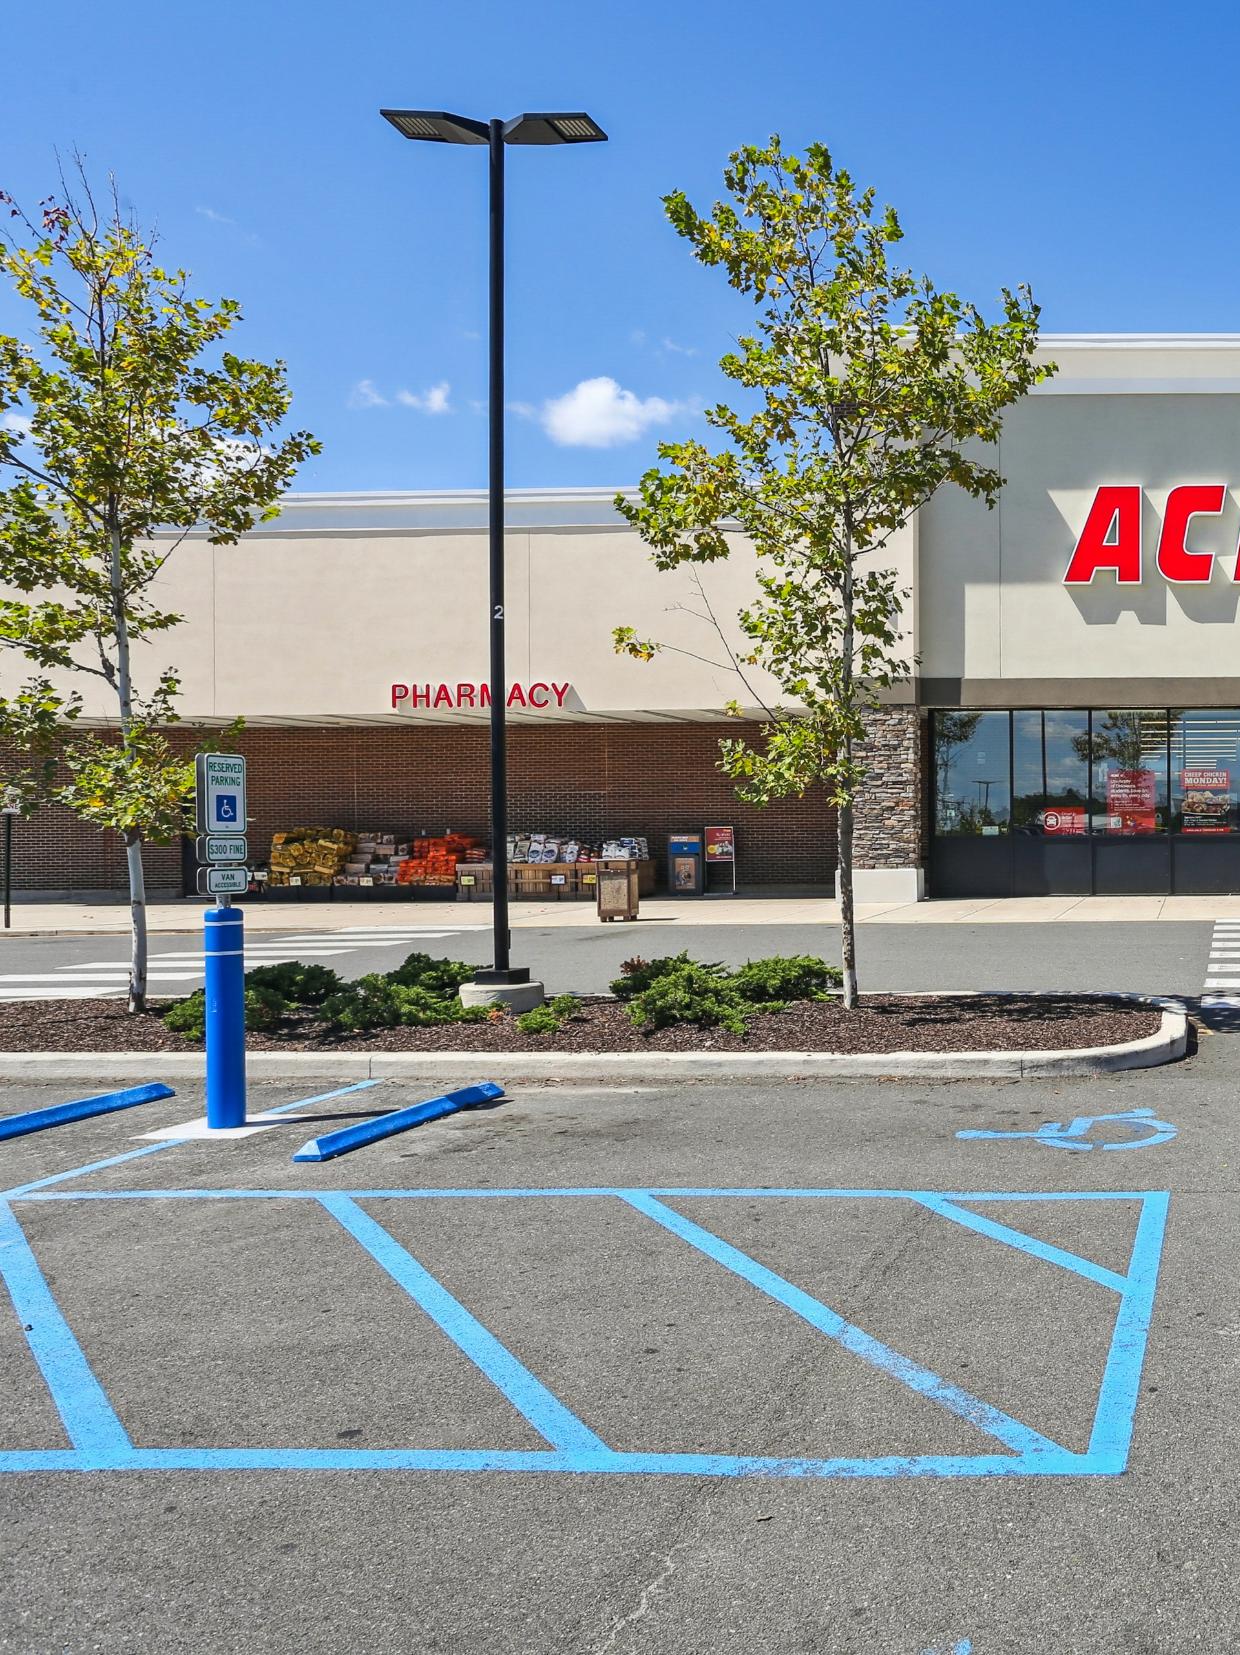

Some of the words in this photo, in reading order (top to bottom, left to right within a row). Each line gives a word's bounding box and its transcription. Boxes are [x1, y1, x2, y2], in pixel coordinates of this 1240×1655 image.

[493, 605, 504, 619] 2
[209, 762, 243, 773] RESERVED
[211, 776, 241, 786] PARKING
[209, 845, 227, 854] $300
[229, 845, 244, 854] FINE
